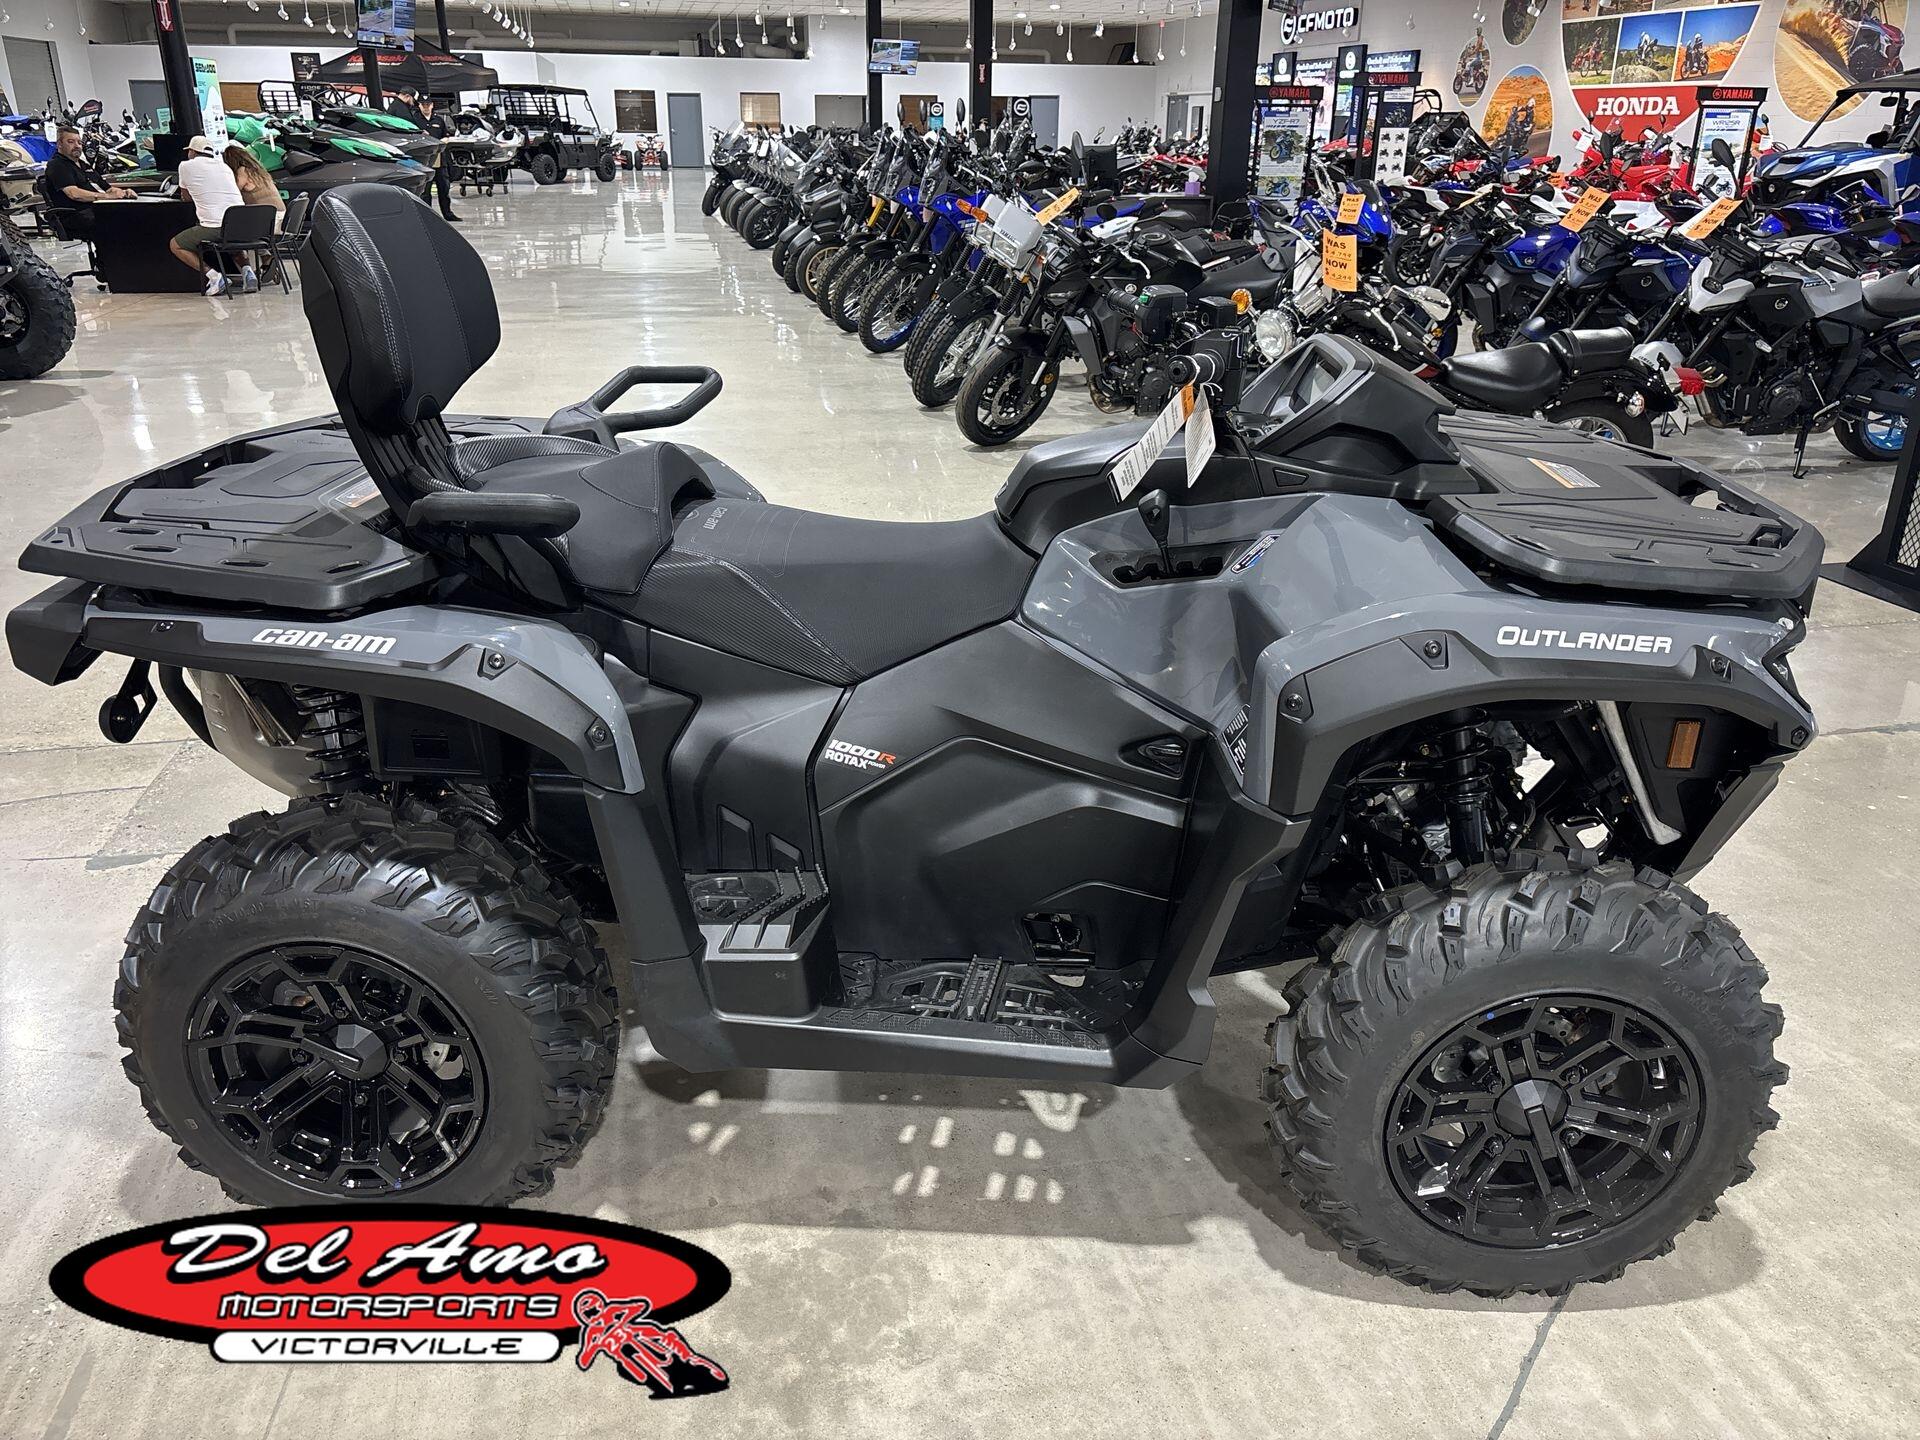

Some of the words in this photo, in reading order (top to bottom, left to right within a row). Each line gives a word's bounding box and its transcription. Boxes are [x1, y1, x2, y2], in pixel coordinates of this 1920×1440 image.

[1298, 7, 1355, 33] CFMOTO
[1377, 74, 1409, 84] YAMAHA
[1279, 87, 1311, 98] YAMAHA
[1722, 88, 1754, 99] YAMAHA
[1595, 96, 1681, 116] HONDA
[1588, 194, 1603, 203] WAS
[1326, 237, 1347, 250] WAS
[1326, 258, 1348, 270] NOW
[252, 628, 397, 655] can-am
[828, 739, 896, 765] 1000R
[824, 748, 869, 770] ROTAX
